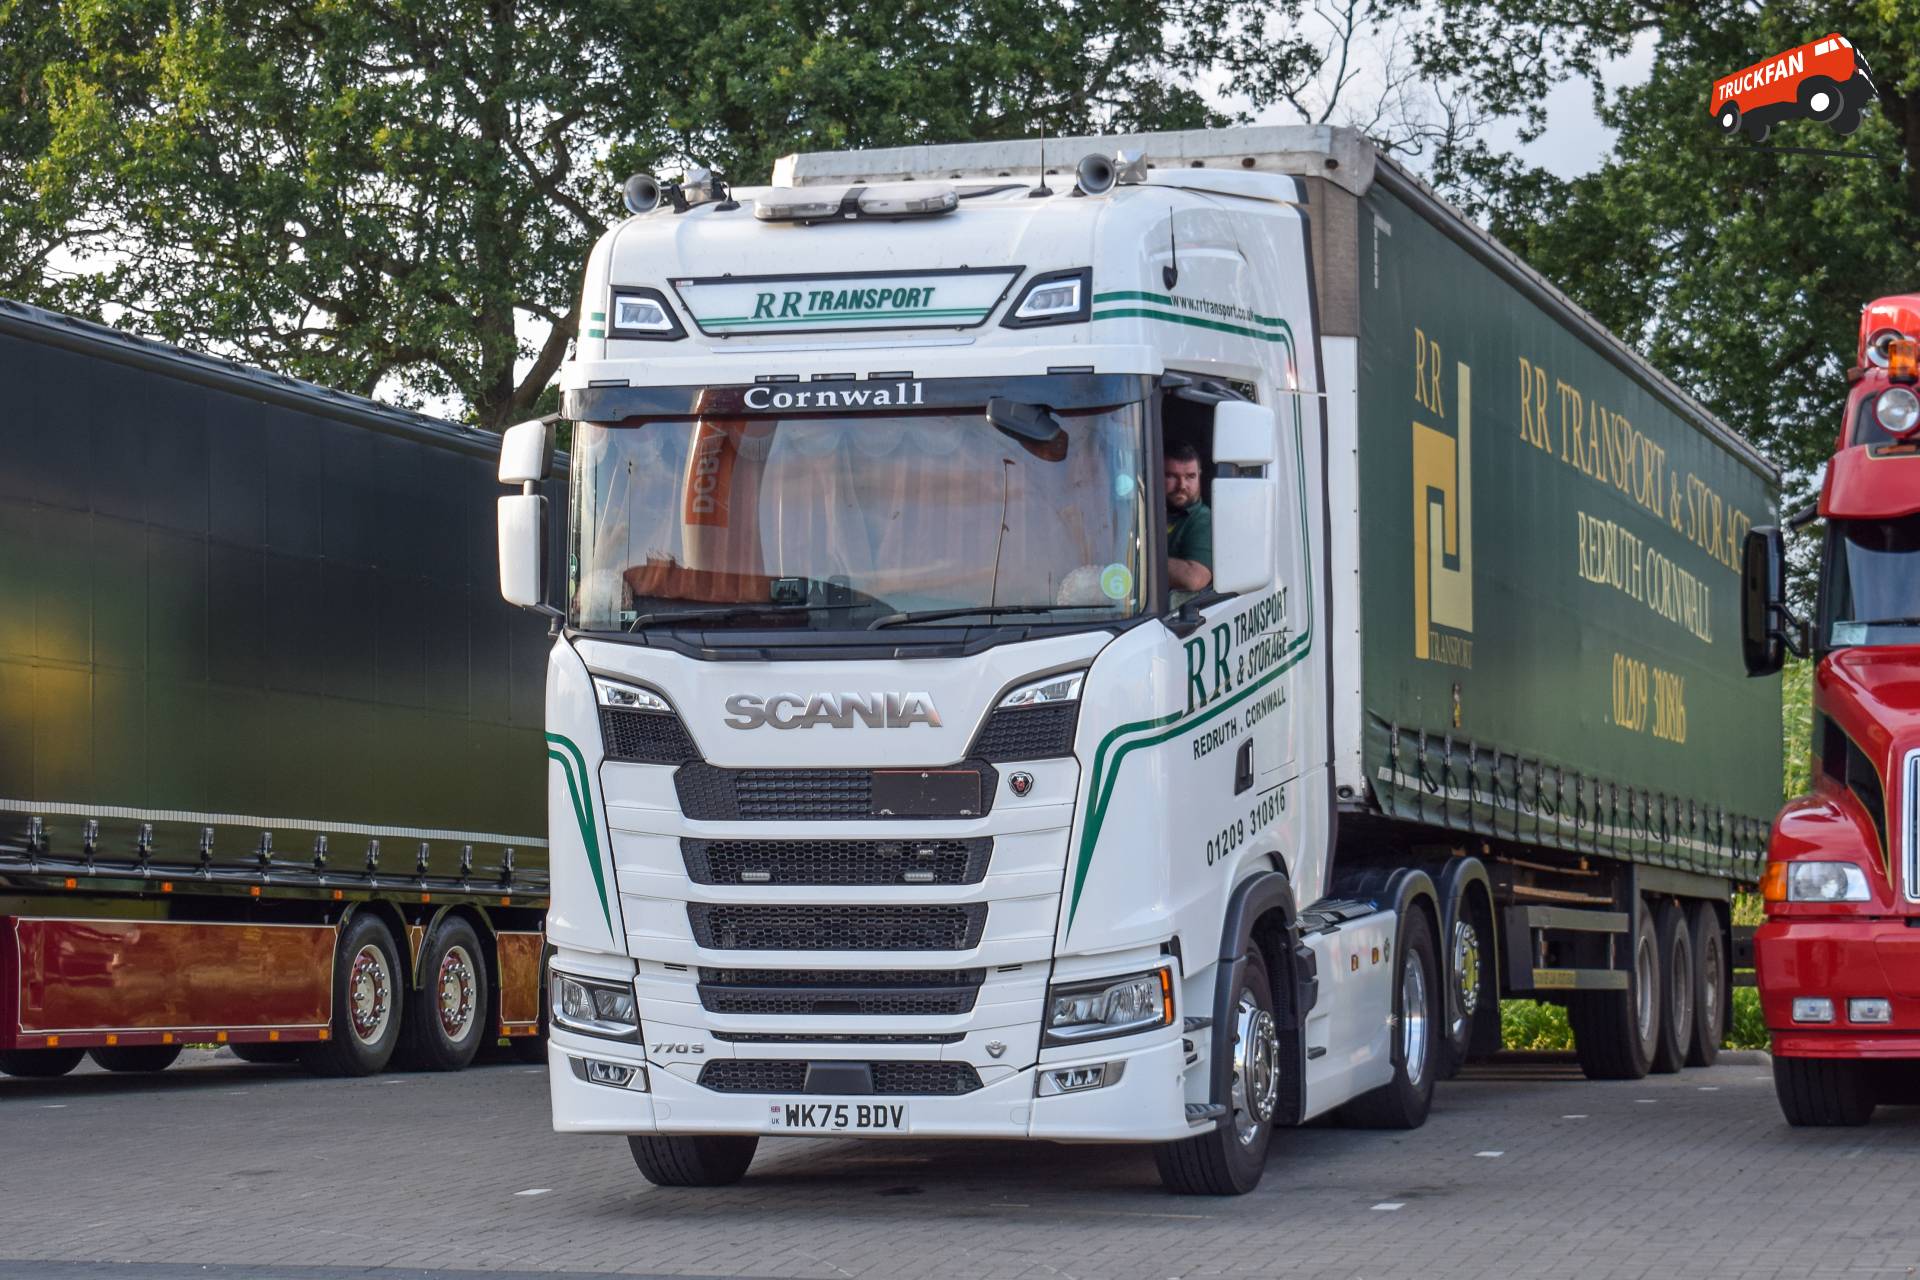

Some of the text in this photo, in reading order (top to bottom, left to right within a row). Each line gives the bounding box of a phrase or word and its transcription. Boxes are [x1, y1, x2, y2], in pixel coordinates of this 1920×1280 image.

[751, 287, 936, 319] RR TRANSPORT
[1170, 294, 1255, 321] www.rrtransport.co.uk
[743, 382, 925, 410] Cornwall
[1414, 328, 1445, 419] RR
[1518, 357, 1552, 454] RR
[1556, 378, 1665, 519] TRANSPORT
[1669, 470, 1683, 533] &
[1577, 511, 1712, 643] REDRUTH CORNWALL
[1234, 587, 1289, 648] TRANSPORT
[1182, 621, 1232, 719] RR
[1236, 627, 1289, 687] & STORAGE
[1429, 631, 1473, 670] TRANSPORT
[723, 691, 943, 730] SCANIA
[1193, 717, 1238, 761] REDRUTH
[1246, 685, 1287, 728] CORNWALL
[1612, 652, 1648, 733] 01209
[1206, 786, 1286, 867] 01209 310816
[785, 1104, 904, 1128] WK75 BDV
